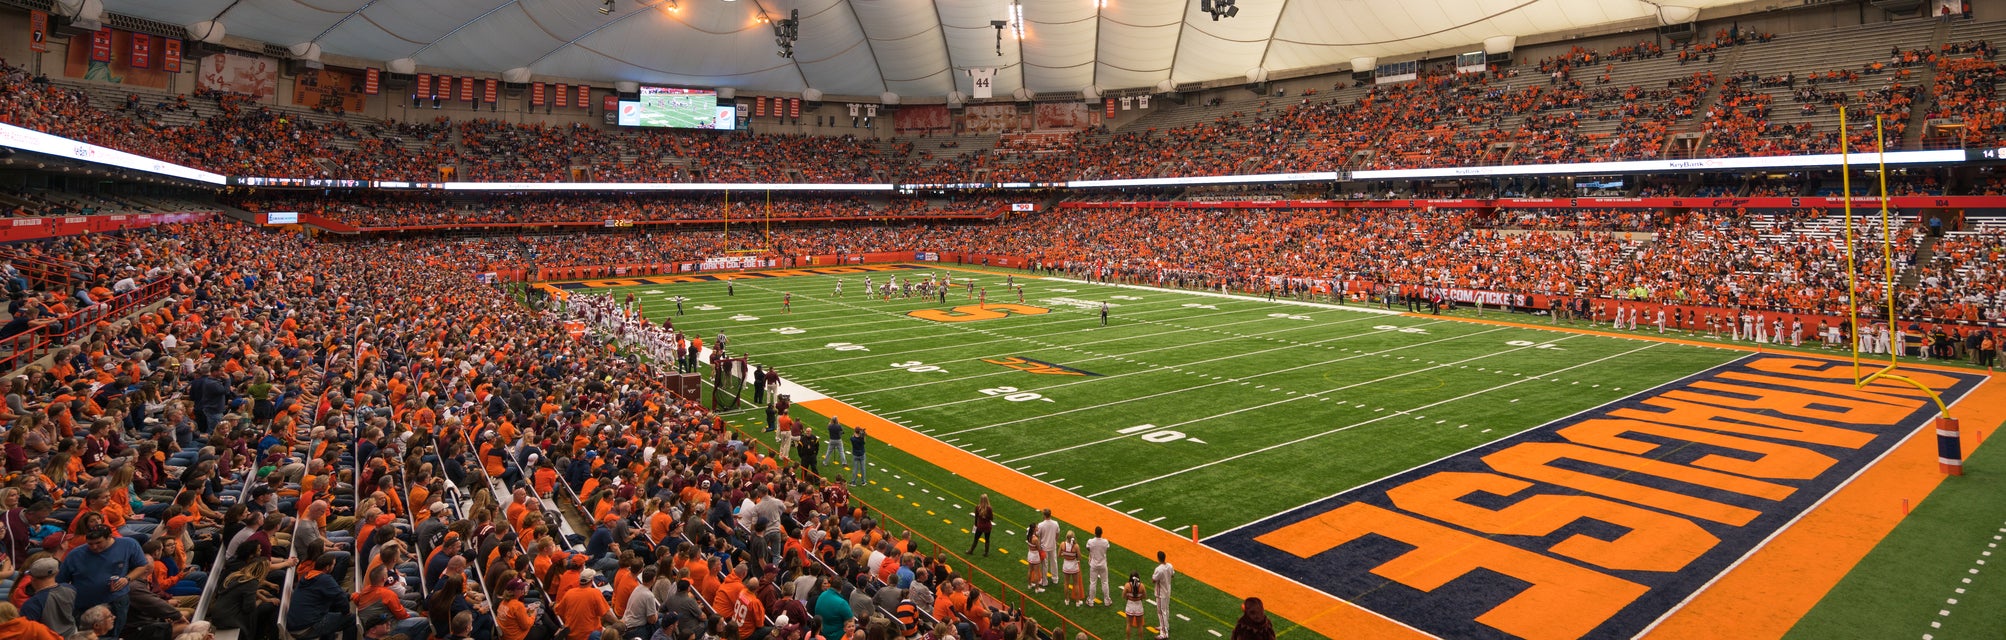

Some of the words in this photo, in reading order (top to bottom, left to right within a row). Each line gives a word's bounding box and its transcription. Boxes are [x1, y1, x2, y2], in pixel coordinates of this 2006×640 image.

[35, 31, 42, 42] 7
[976, 78, 990, 87] 44
[1983, 150, 1994, 158] 14
[1936, 199, 1947, 207] 104
[614, 219, 623, 227] 22
[726, 259, 756, 268] COLEGE
[757, 259, 776, 268] TEM
[889, 361, 942, 372] 30
[977, 386, 1043, 402] 20
[1116, 424, 1187, 443] 10
[732, 599, 748, 627] 99
